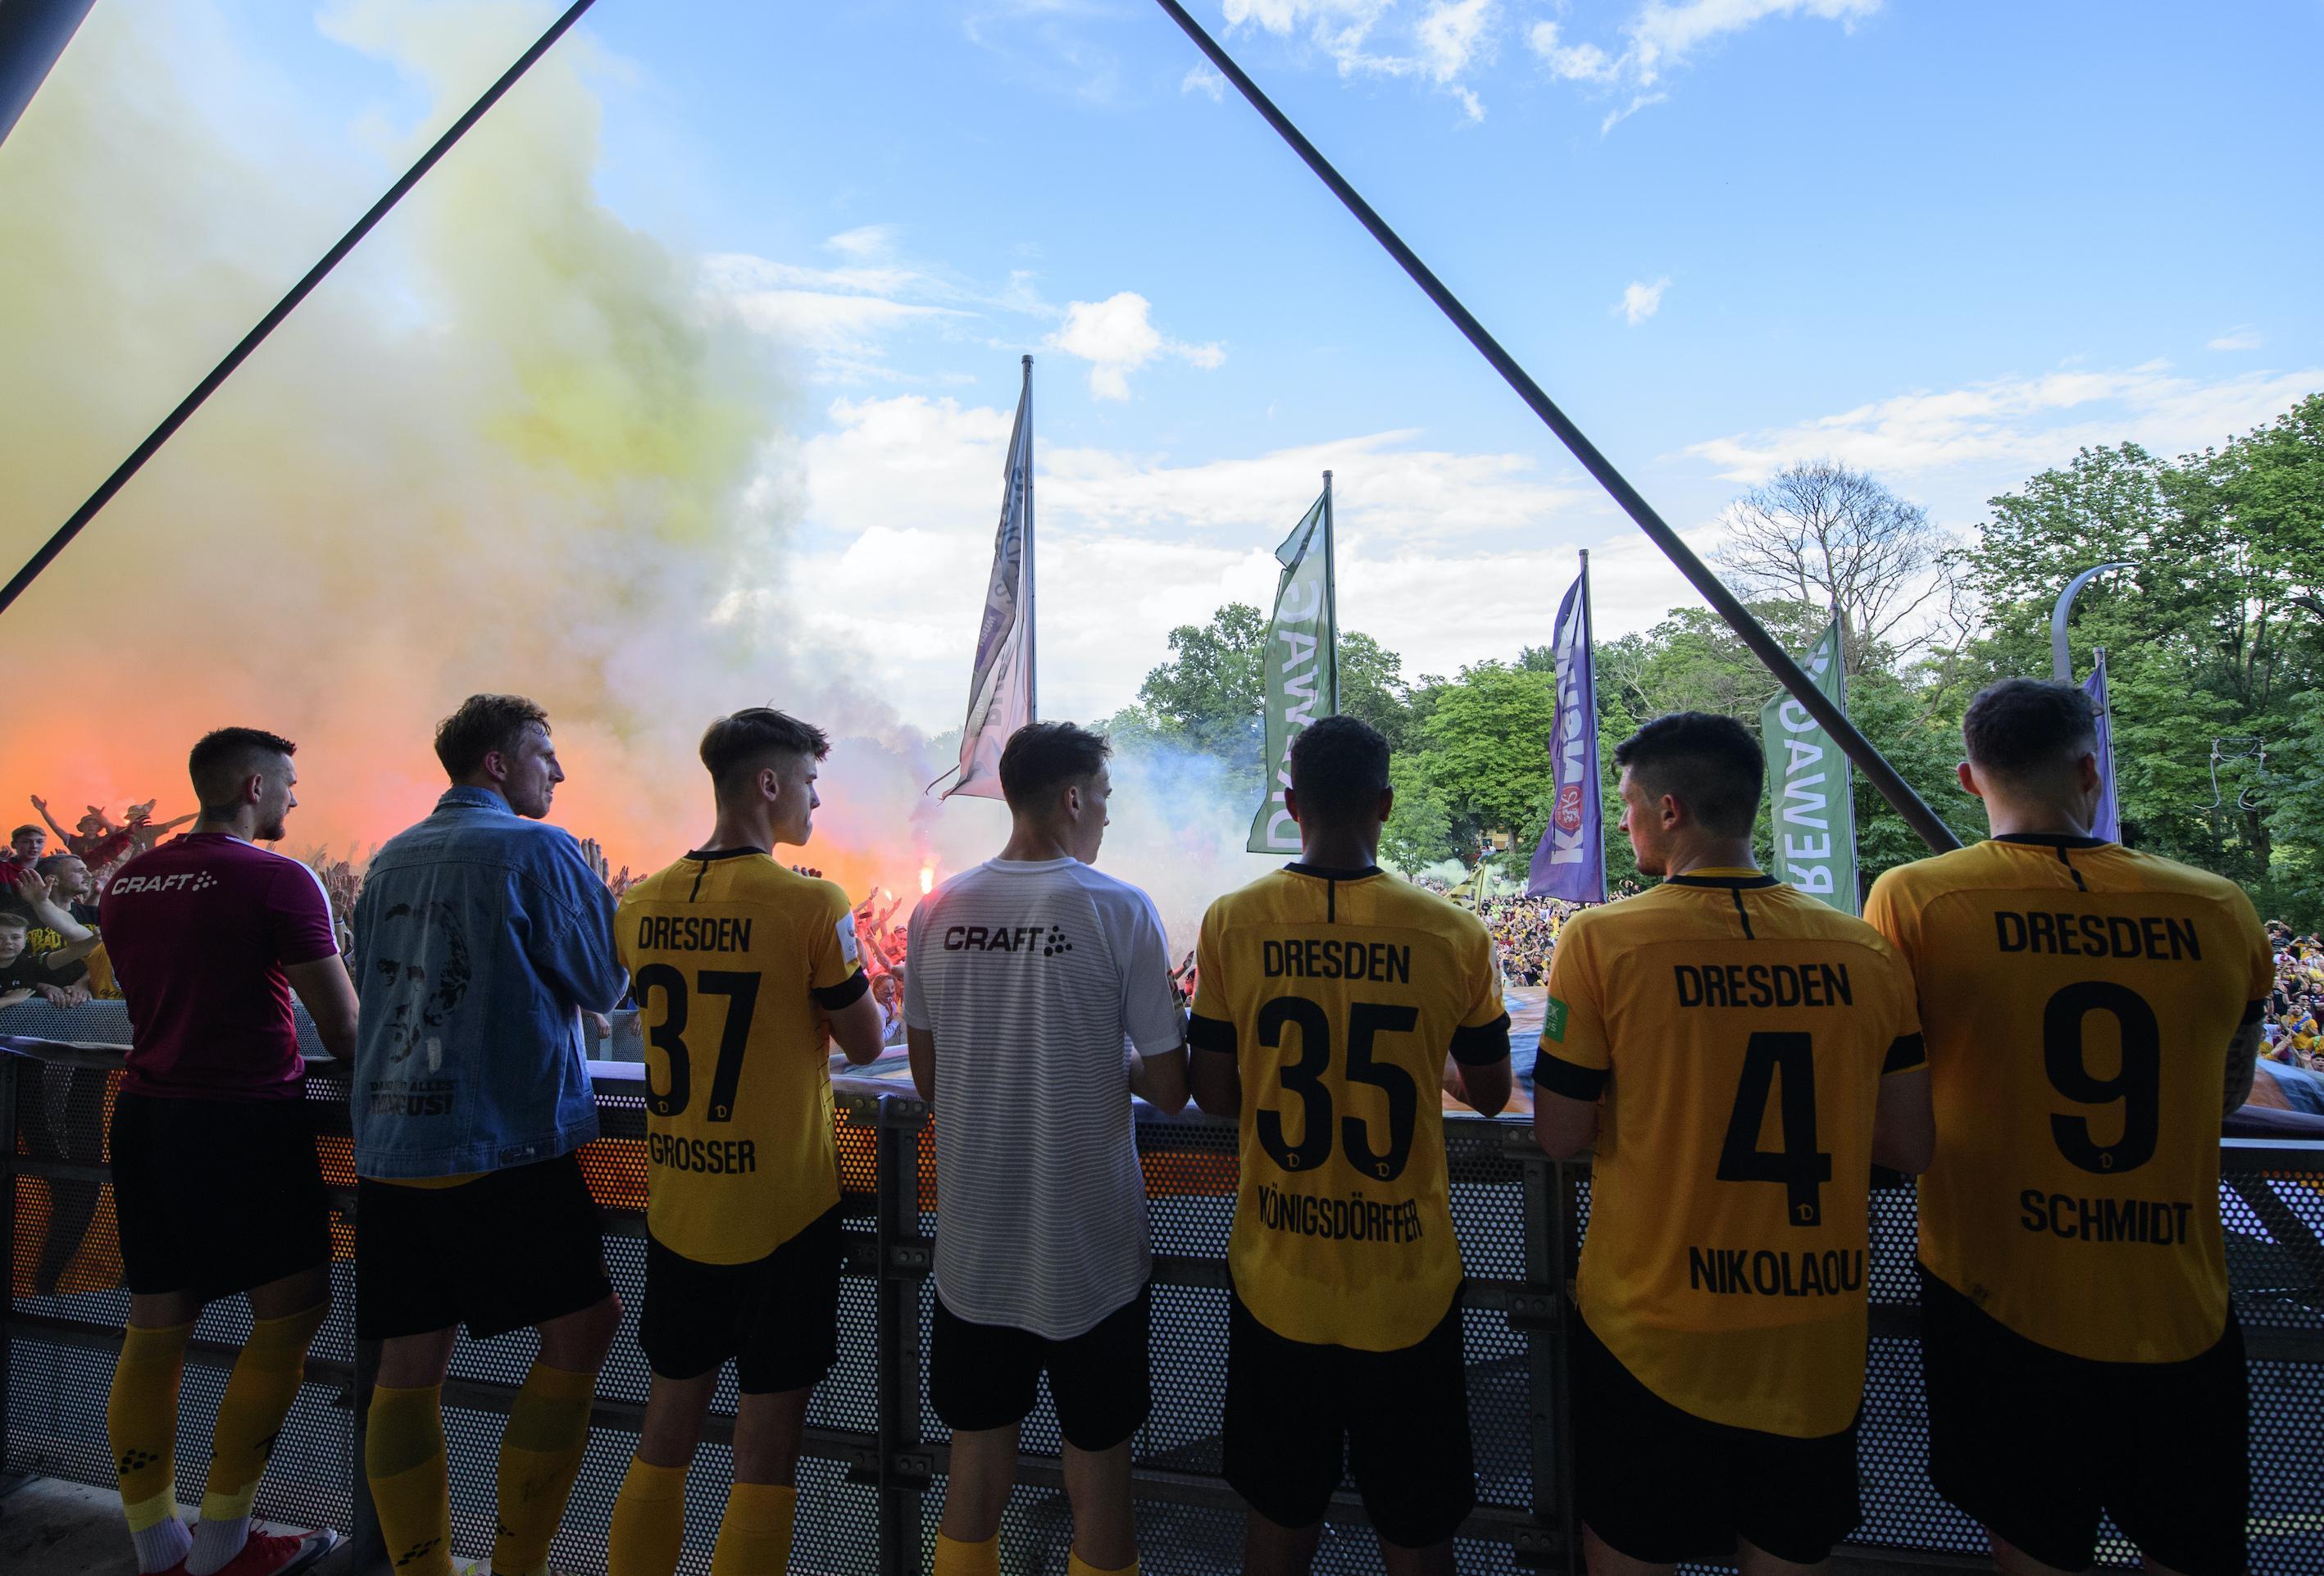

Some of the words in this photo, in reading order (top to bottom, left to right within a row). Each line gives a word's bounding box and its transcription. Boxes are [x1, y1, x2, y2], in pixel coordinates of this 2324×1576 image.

[111, 874, 195, 895] CRAFT
[638, 915, 753, 953] DRESDEN
[944, 925, 1044, 952] CRAFT
[1994, 911, 2203, 961] DRESDEN
[1263, 938, 1411, 984] DRESDEN
[1674, 963, 1853, 1008] DRESDEN
[634, 963, 762, 1123] 37
[1256, 996, 1420, 1182] 35
[2044, 981, 2160, 1174] 9
[648, 1132, 756, 1175] GROSSER
[1716, 1032, 1832, 1227] 4
[1258, 1185, 1422, 1243] KÖNIGSDÖRFFER
[2020, 1189, 2193, 1246] SCHMIDT
[1689, 1247, 1863, 1297] NIKOLAOU
